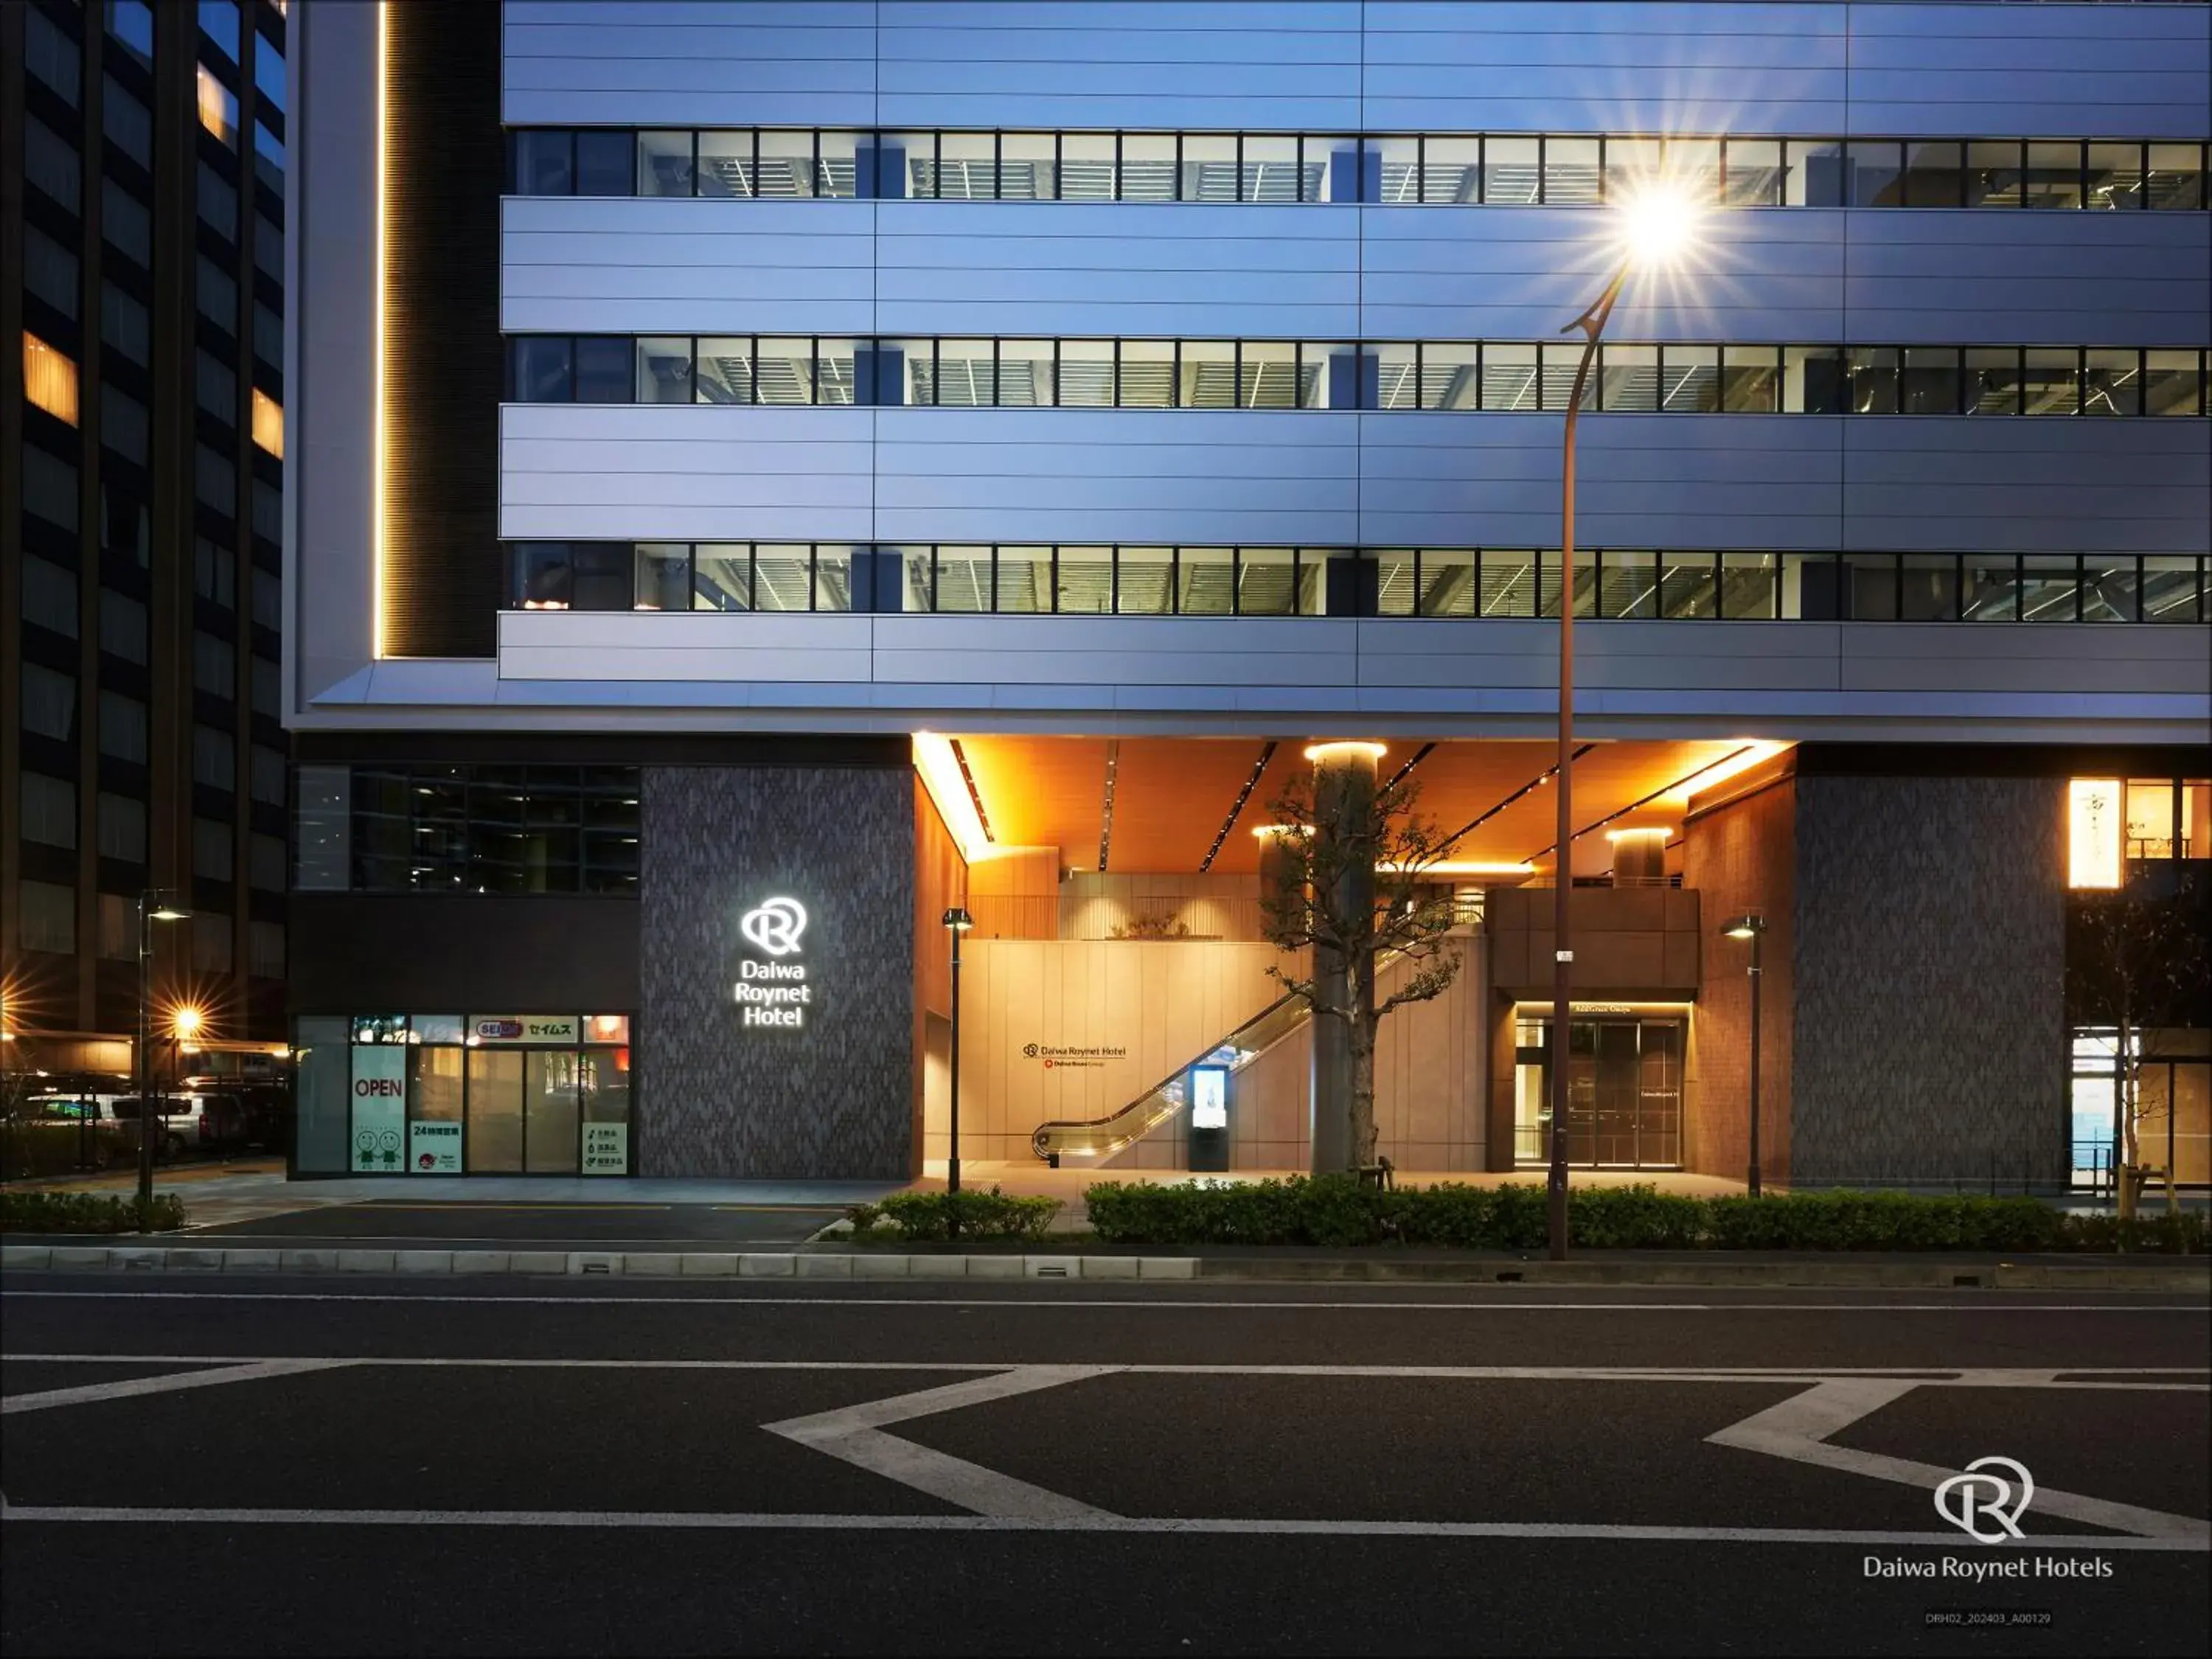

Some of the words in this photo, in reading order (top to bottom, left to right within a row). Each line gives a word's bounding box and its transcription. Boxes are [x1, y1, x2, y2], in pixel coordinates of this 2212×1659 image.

[741, 960, 805, 979] Daiwa
[734, 983, 811, 1006] Roynet
[744, 1006, 802, 1026] Hotel
[529, 1023, 572, 1035] セイムス
[1040, 1046, 1068, 1055] Daiwa
[1068, 1046, 1100, 1057] Roynet
[1102, 1046, 1126, 1055] Hotel
[355, 1078, 402, 1097] OPEN
